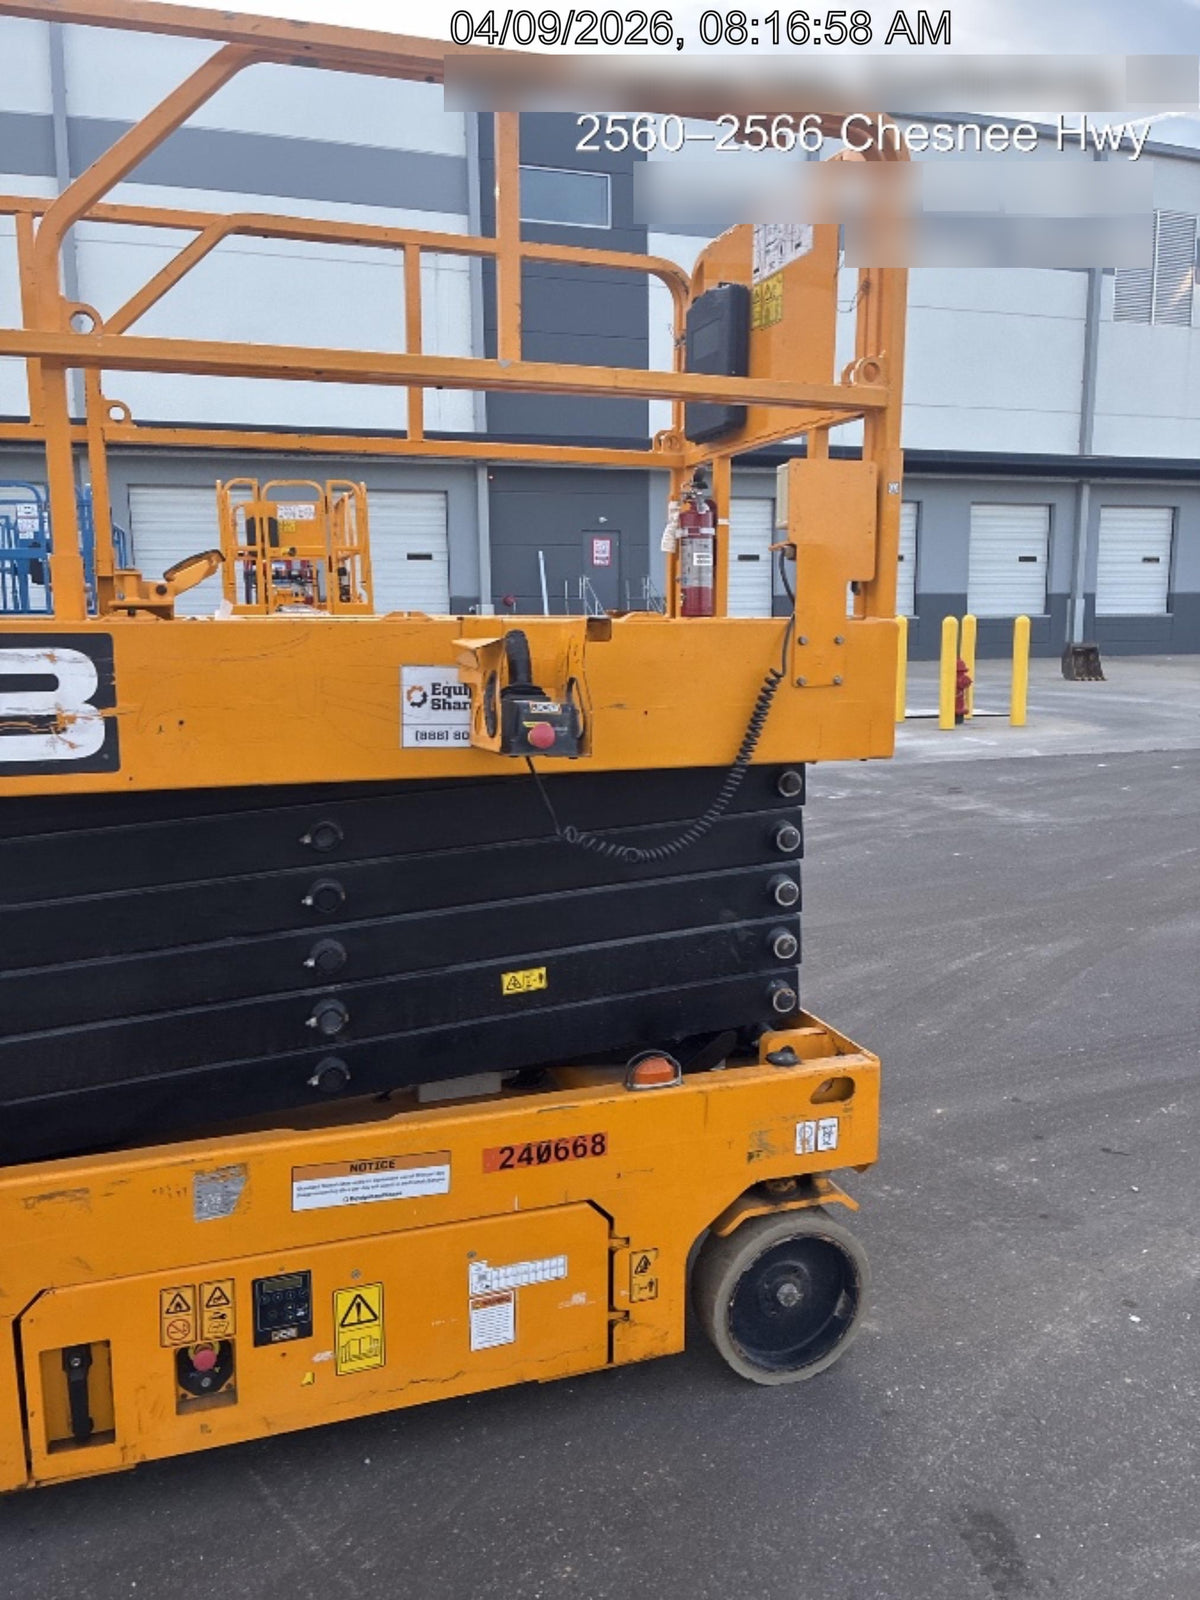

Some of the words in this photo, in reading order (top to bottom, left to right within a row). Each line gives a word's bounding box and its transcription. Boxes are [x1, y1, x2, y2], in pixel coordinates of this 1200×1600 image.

[431, 699, 472, 710] Shar
[499, 1132, 605, 1170] 240668
[349, 1159, 396, 1173] NOTICE
